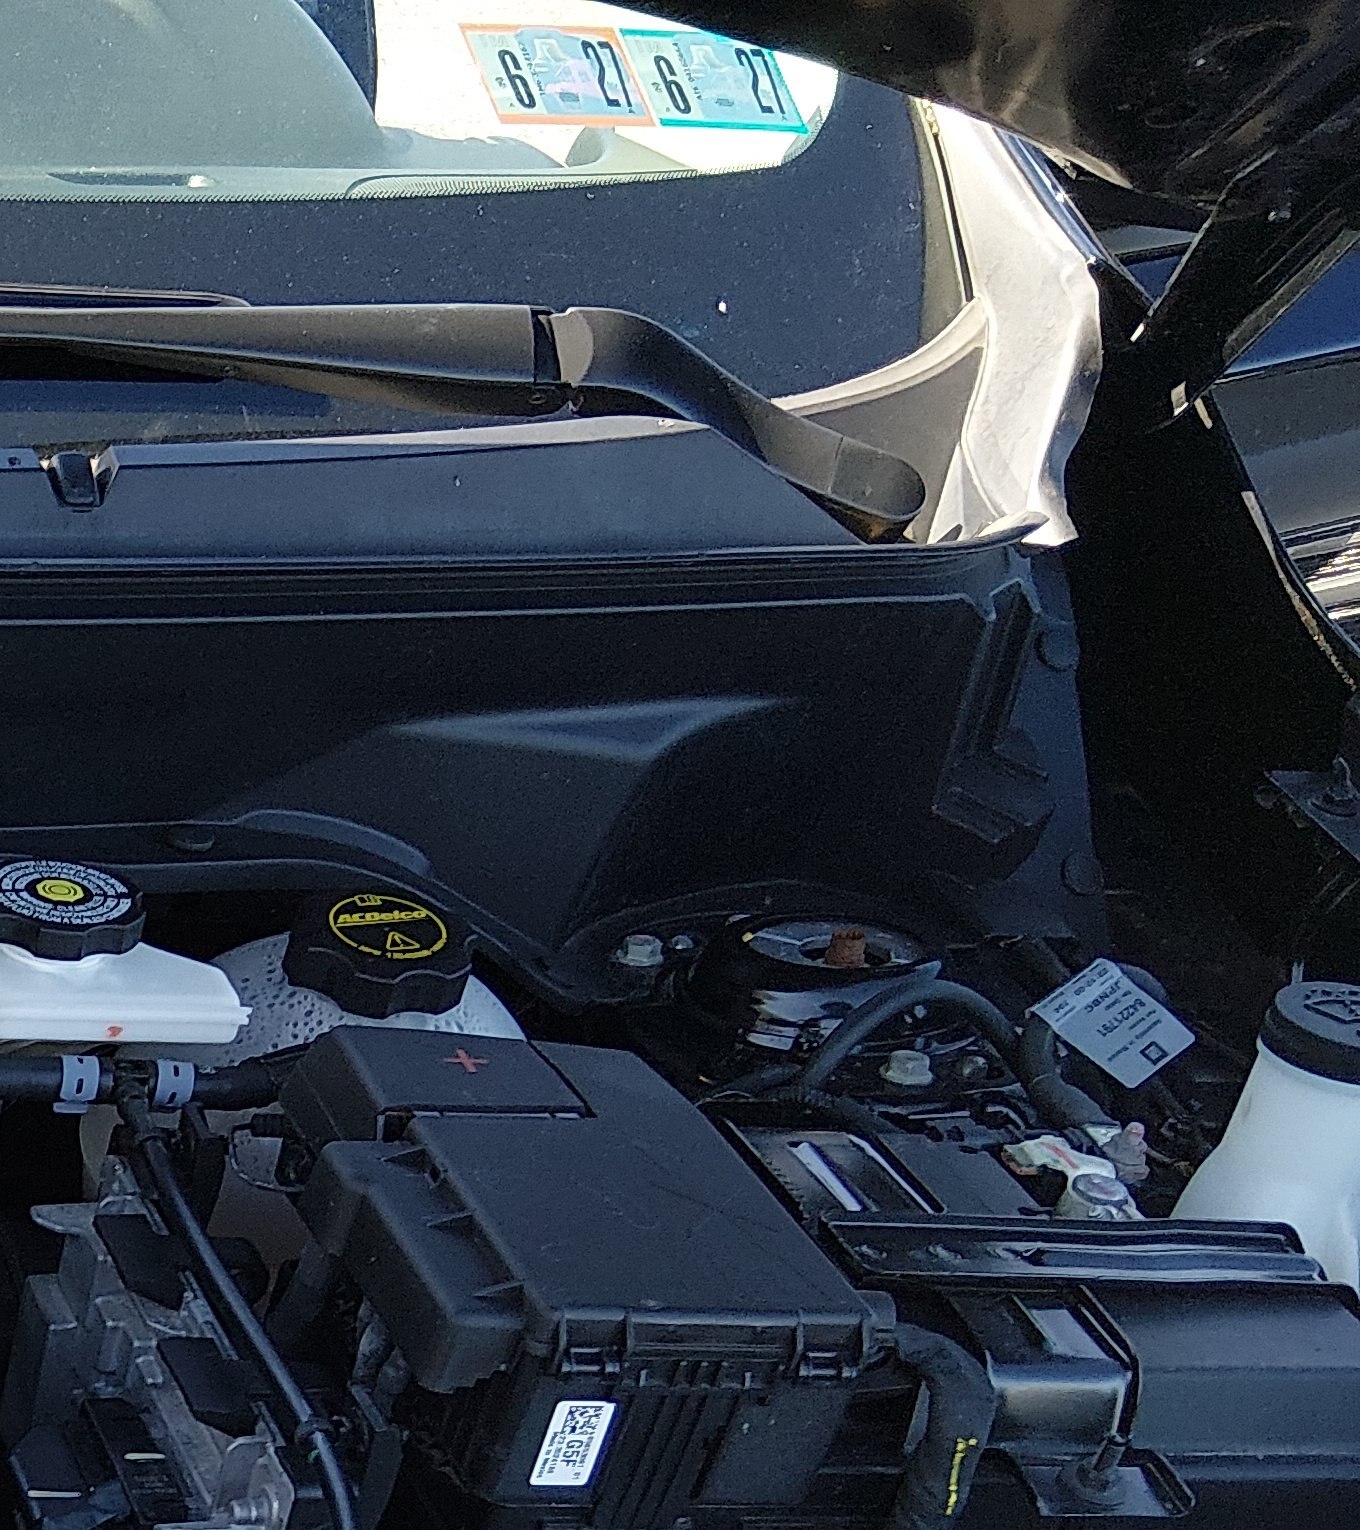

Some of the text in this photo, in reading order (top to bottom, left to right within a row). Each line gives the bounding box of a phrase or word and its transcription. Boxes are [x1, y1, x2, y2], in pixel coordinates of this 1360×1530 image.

[498, 49, 536, 109] 6
[581, 40, 633, 108] 27
[654, 55, 691, 114] 6
[735, 48, 786, 115] 27
